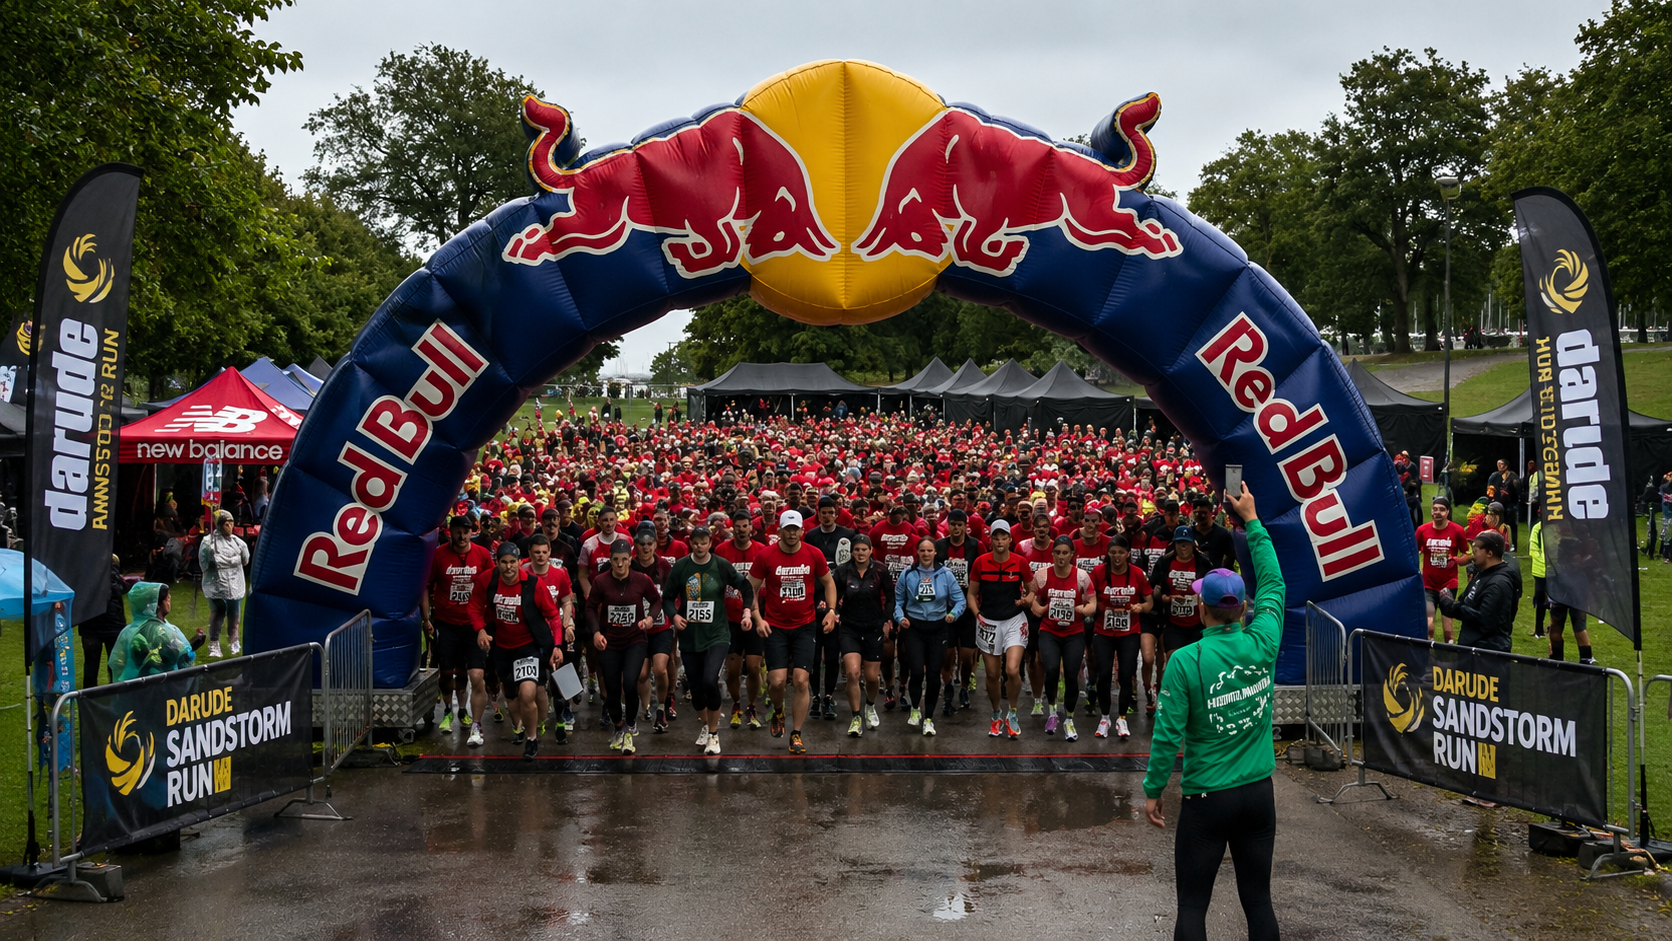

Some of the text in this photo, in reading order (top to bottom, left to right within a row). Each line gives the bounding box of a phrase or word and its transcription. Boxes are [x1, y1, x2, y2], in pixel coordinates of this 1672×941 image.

[45, 318, 99, 532] darude
[137, 439, 283, 460] new balance
[1195, 312, 1385, 581] Red Bull
[294, 319, 489, 596] Red Bull
[166, 686, 233, 727] DARUDE
[1433, 666, 1499, 703] DARUDE
[166, 701, 292, 769] SANDSTORM
[1432, 696, 1577, 758] SANDSTORM
[1433, 732, 1477, 775] RUN
[167, 762, 213, 809] RUN
